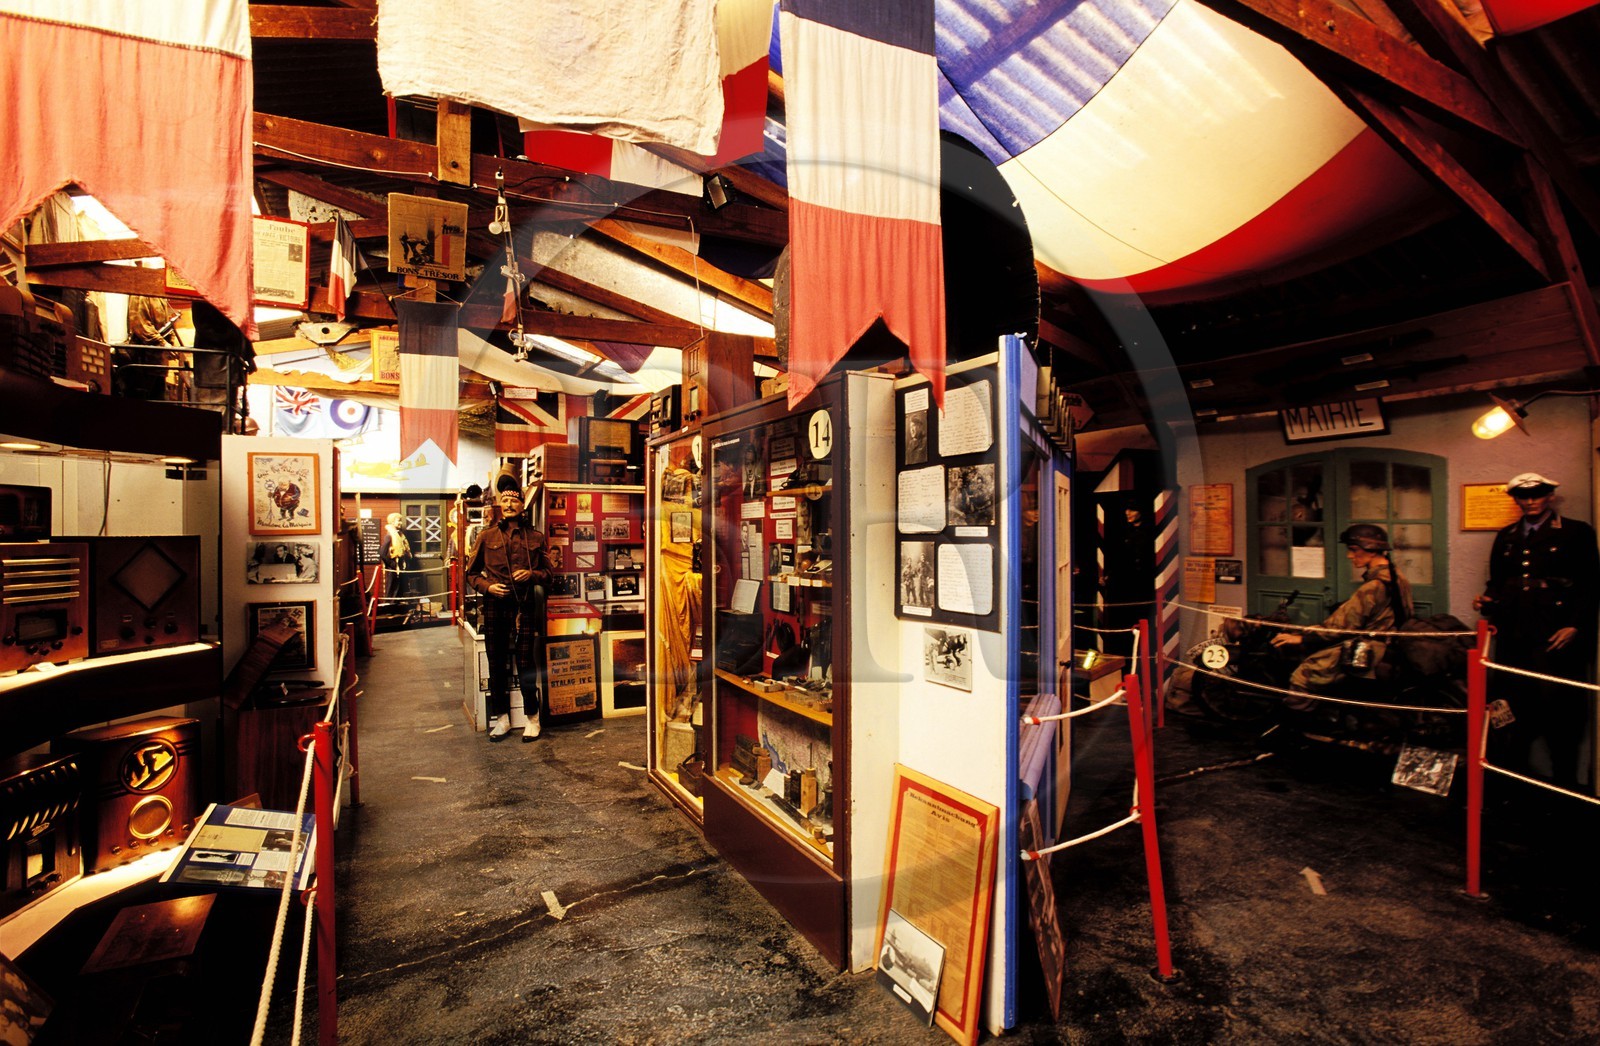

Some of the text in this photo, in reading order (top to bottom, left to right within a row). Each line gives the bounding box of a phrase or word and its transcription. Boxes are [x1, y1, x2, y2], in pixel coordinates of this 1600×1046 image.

[396, 266, 420, 276] BONS
[380, 371, 400, 380] BONS
[1286, 400, 1375, 435] MAIRIE
[813, 417, 831, 449] 14
[1207, 648, 1226, 663] 23
[550, 678, 576, 688] STALAG
[930, 810, 951, 823] Avis
